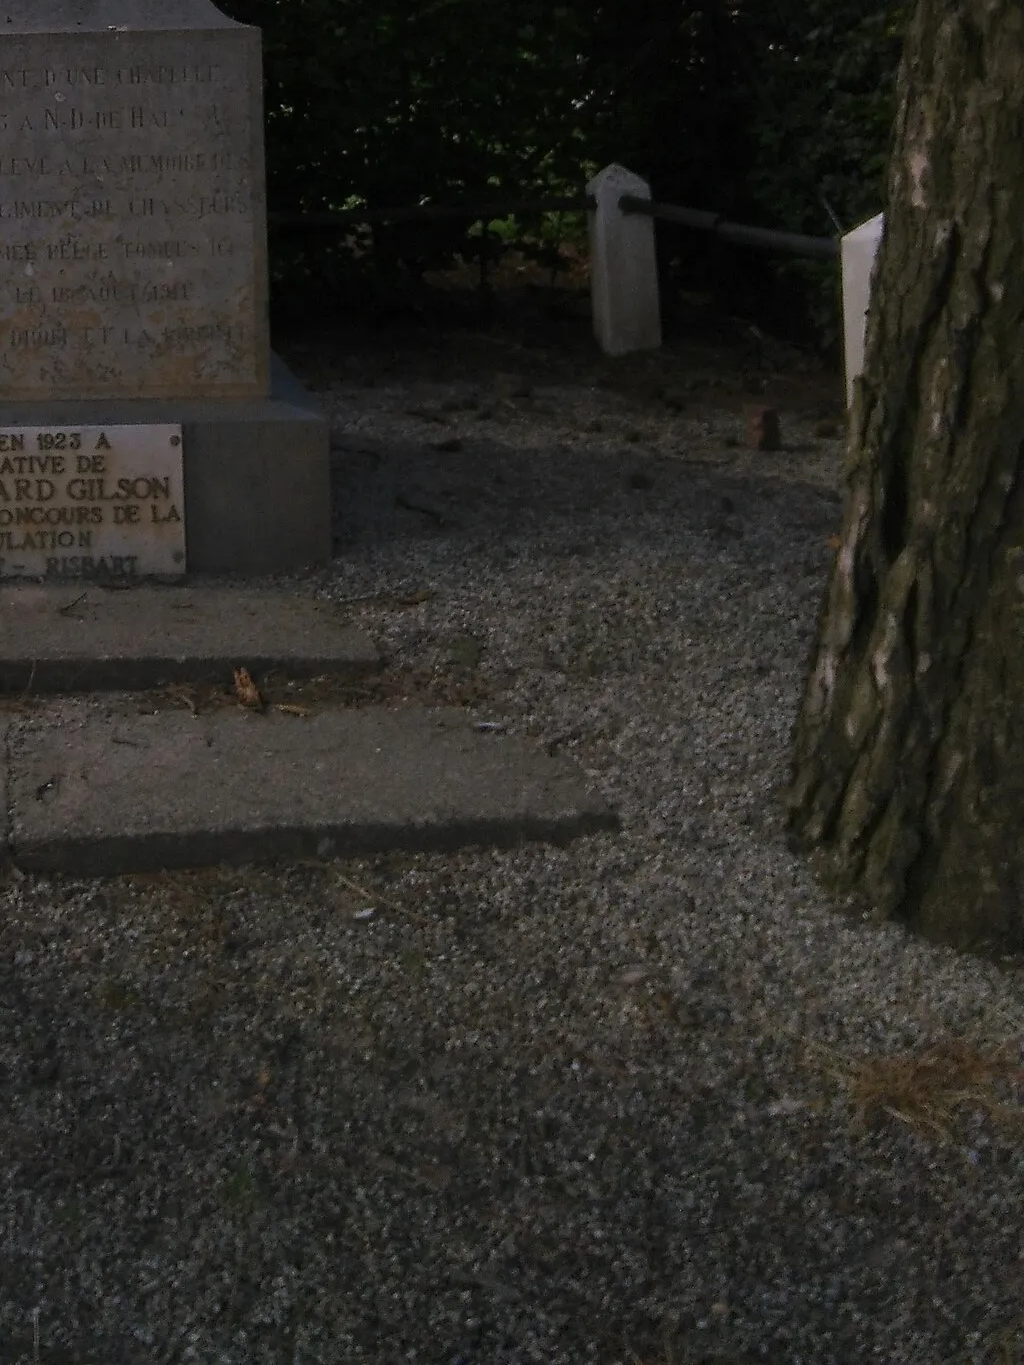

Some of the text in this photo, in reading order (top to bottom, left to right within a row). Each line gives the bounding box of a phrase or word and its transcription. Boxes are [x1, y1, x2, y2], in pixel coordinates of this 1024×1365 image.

[118, 65, 221, 85] CHAPELLE
[20, 115, 33, 131] A
[36, 433, 81, 450] 1923
[94, 432, 111, 450] A
[76, 455, 106, 473] DE
[66, 477, 172, 500] GILSON
[113, 505, 141, 524] DE
[150, 504, 181, 523] LA
